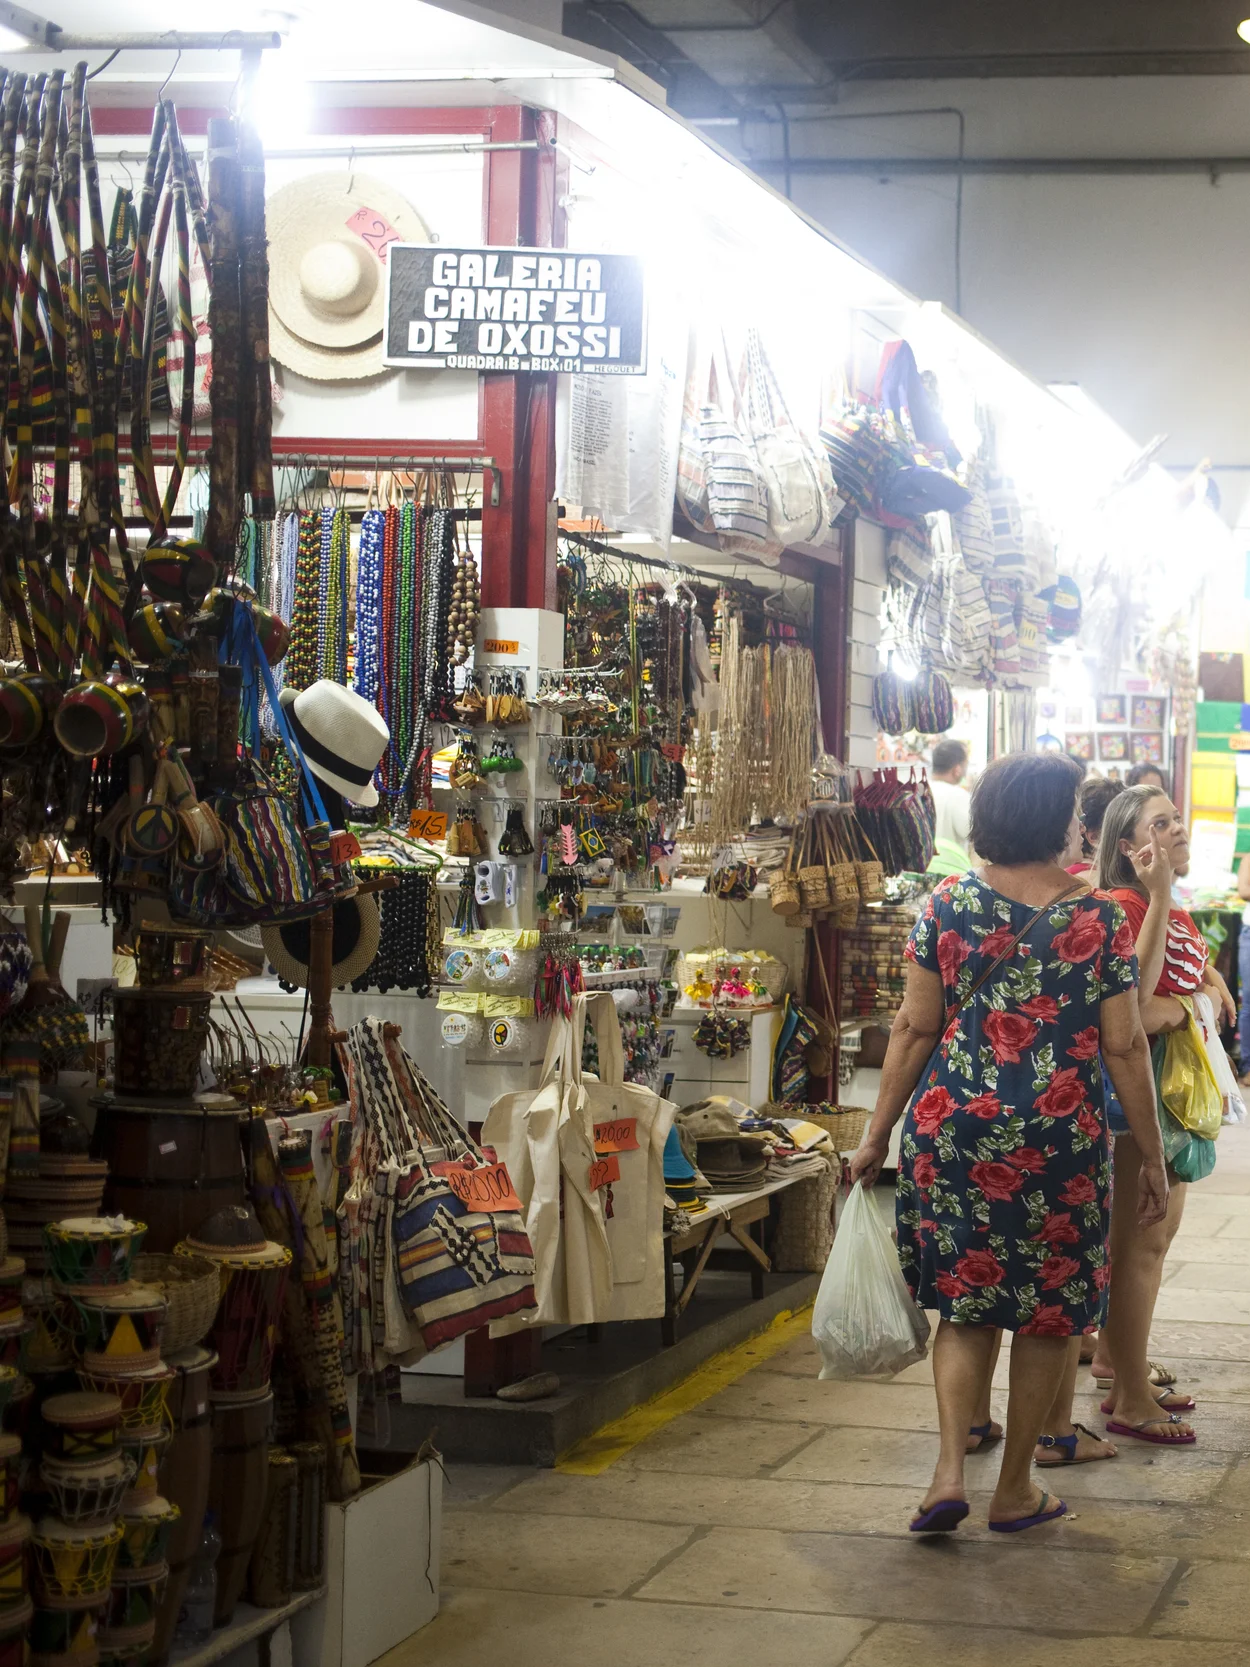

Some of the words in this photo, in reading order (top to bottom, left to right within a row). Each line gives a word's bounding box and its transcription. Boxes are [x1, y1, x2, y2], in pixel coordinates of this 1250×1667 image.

[432, 253, 601, 291] GALERIA
[423, 287, 606, 324] CAMAFEU
[408, 320, 459, 353] DE
[477, 323, 622, 358] OXOSSI
[594, 365, 637, 373] HEGOUET
[450, 1167, 512, 1206] R$10,00
